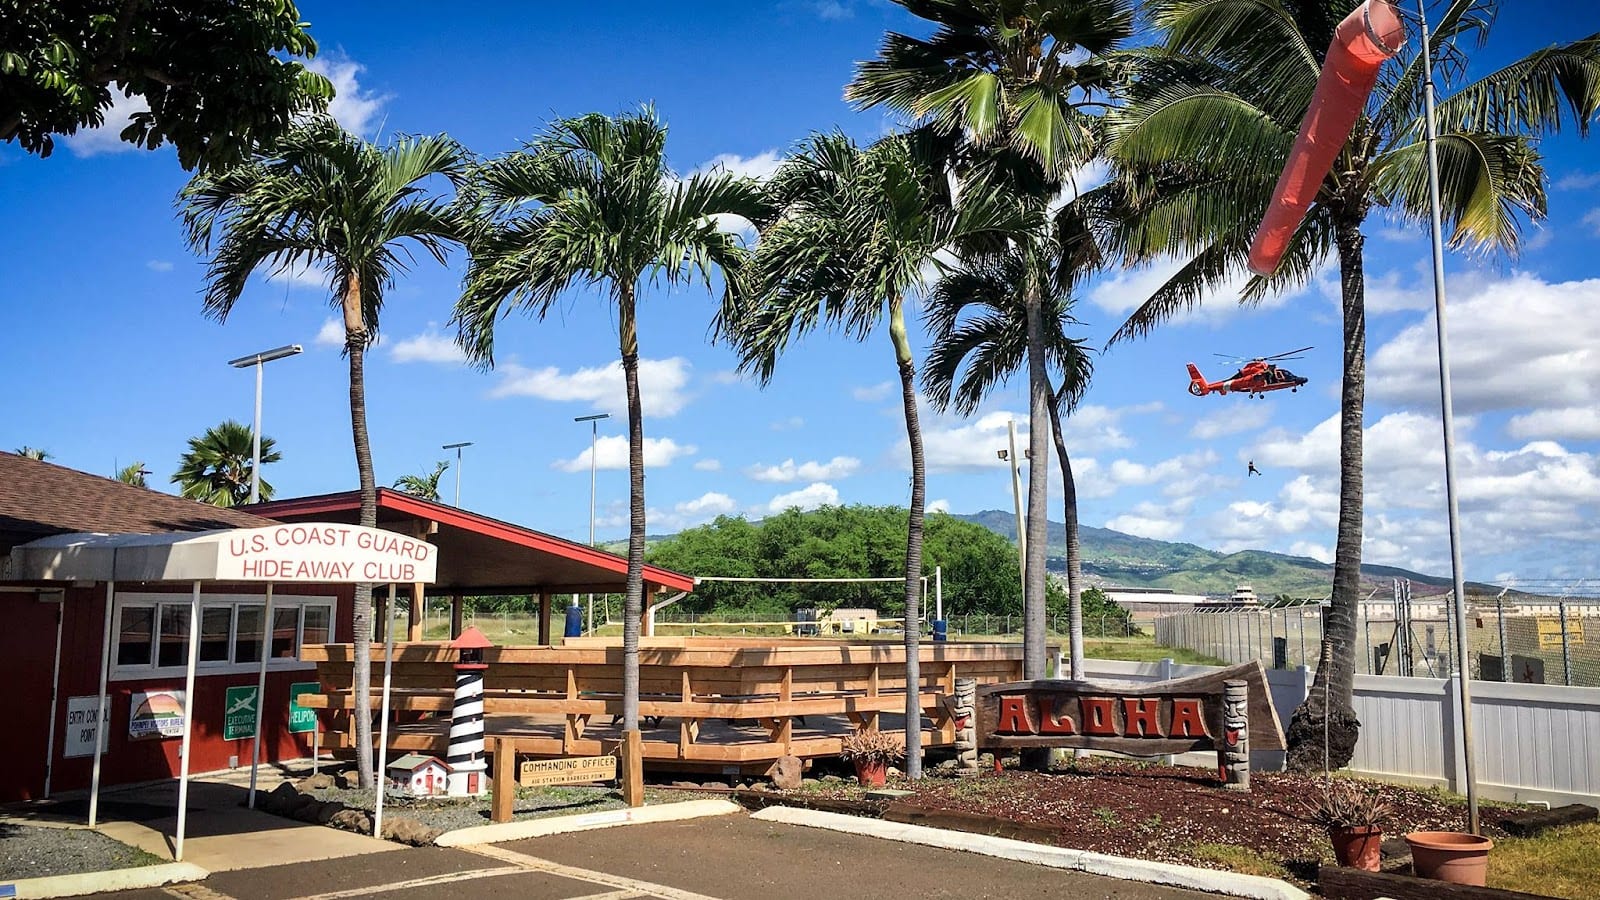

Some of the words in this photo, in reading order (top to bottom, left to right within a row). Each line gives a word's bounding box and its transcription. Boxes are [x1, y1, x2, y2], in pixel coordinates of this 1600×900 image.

[230, 534, 269, 557] U.S.
[275, 527, 351, 547] COAST
[357, 531, 429, 562] GUARD
[243, 559, 354, 580] HIDEAWAY
[363, 561, 416, 581] CLUB
[69, 710, 86, 725] ENTRY
[86, 708, 108, 723] CONL
[170, 718, 185, 727] BUREA
[228, 714, 255, 725] EXECUTIVE
[290, 710, 315, 723] HELIPOR
[998, 695, 1209, 738] ALOHA
[80, 728, 96, 743] POINT
[228, 725, 254, 735] TERMINAL
[523, 760, 578, 772] COMMANDING
[582, 758, 615, 769] OFFICER
